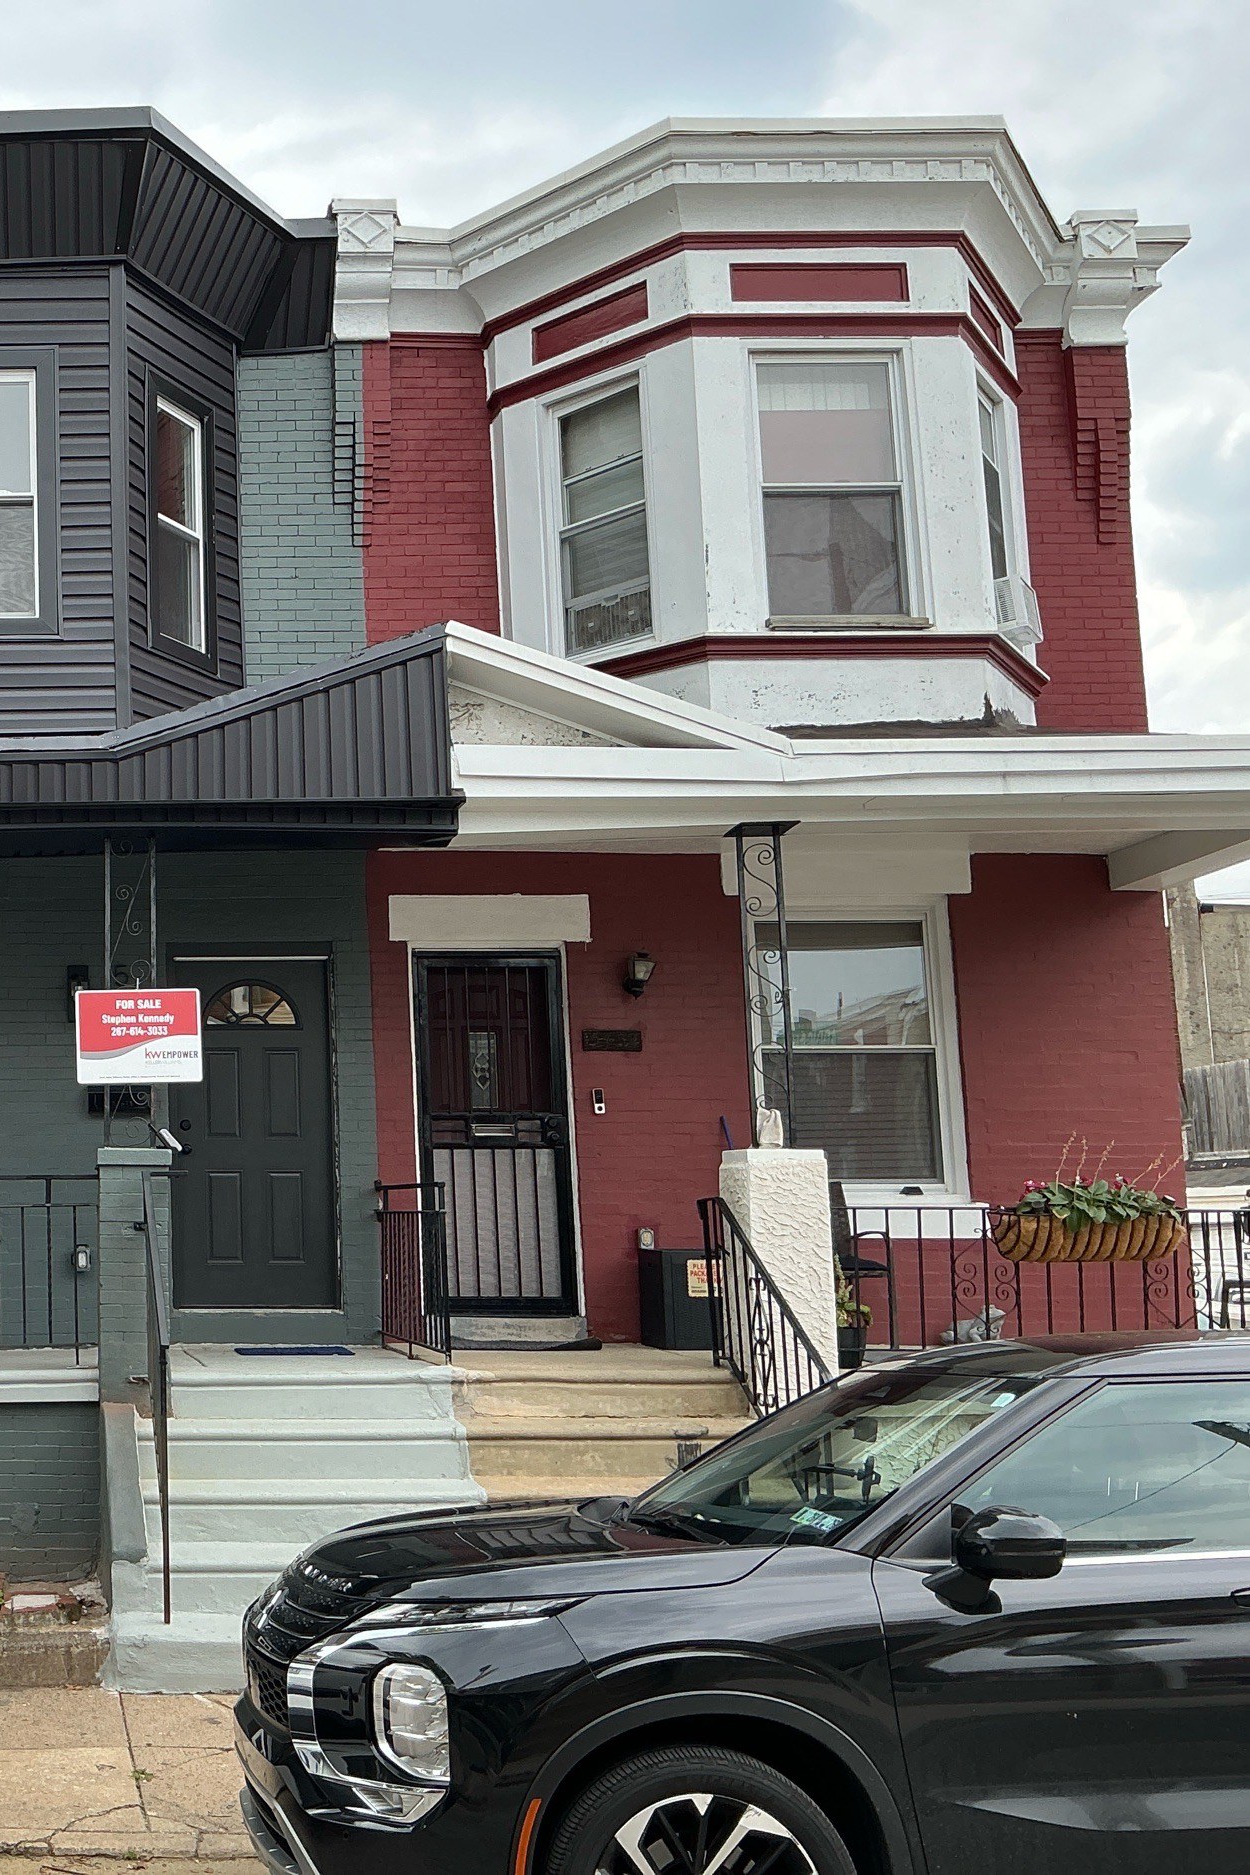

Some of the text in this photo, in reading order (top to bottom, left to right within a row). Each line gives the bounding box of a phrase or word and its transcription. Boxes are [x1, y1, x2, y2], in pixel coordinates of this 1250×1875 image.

[115, 999, 162, 1010] FOR SALE
[101, 1013, 175, 1026] Stephen Kennedy
